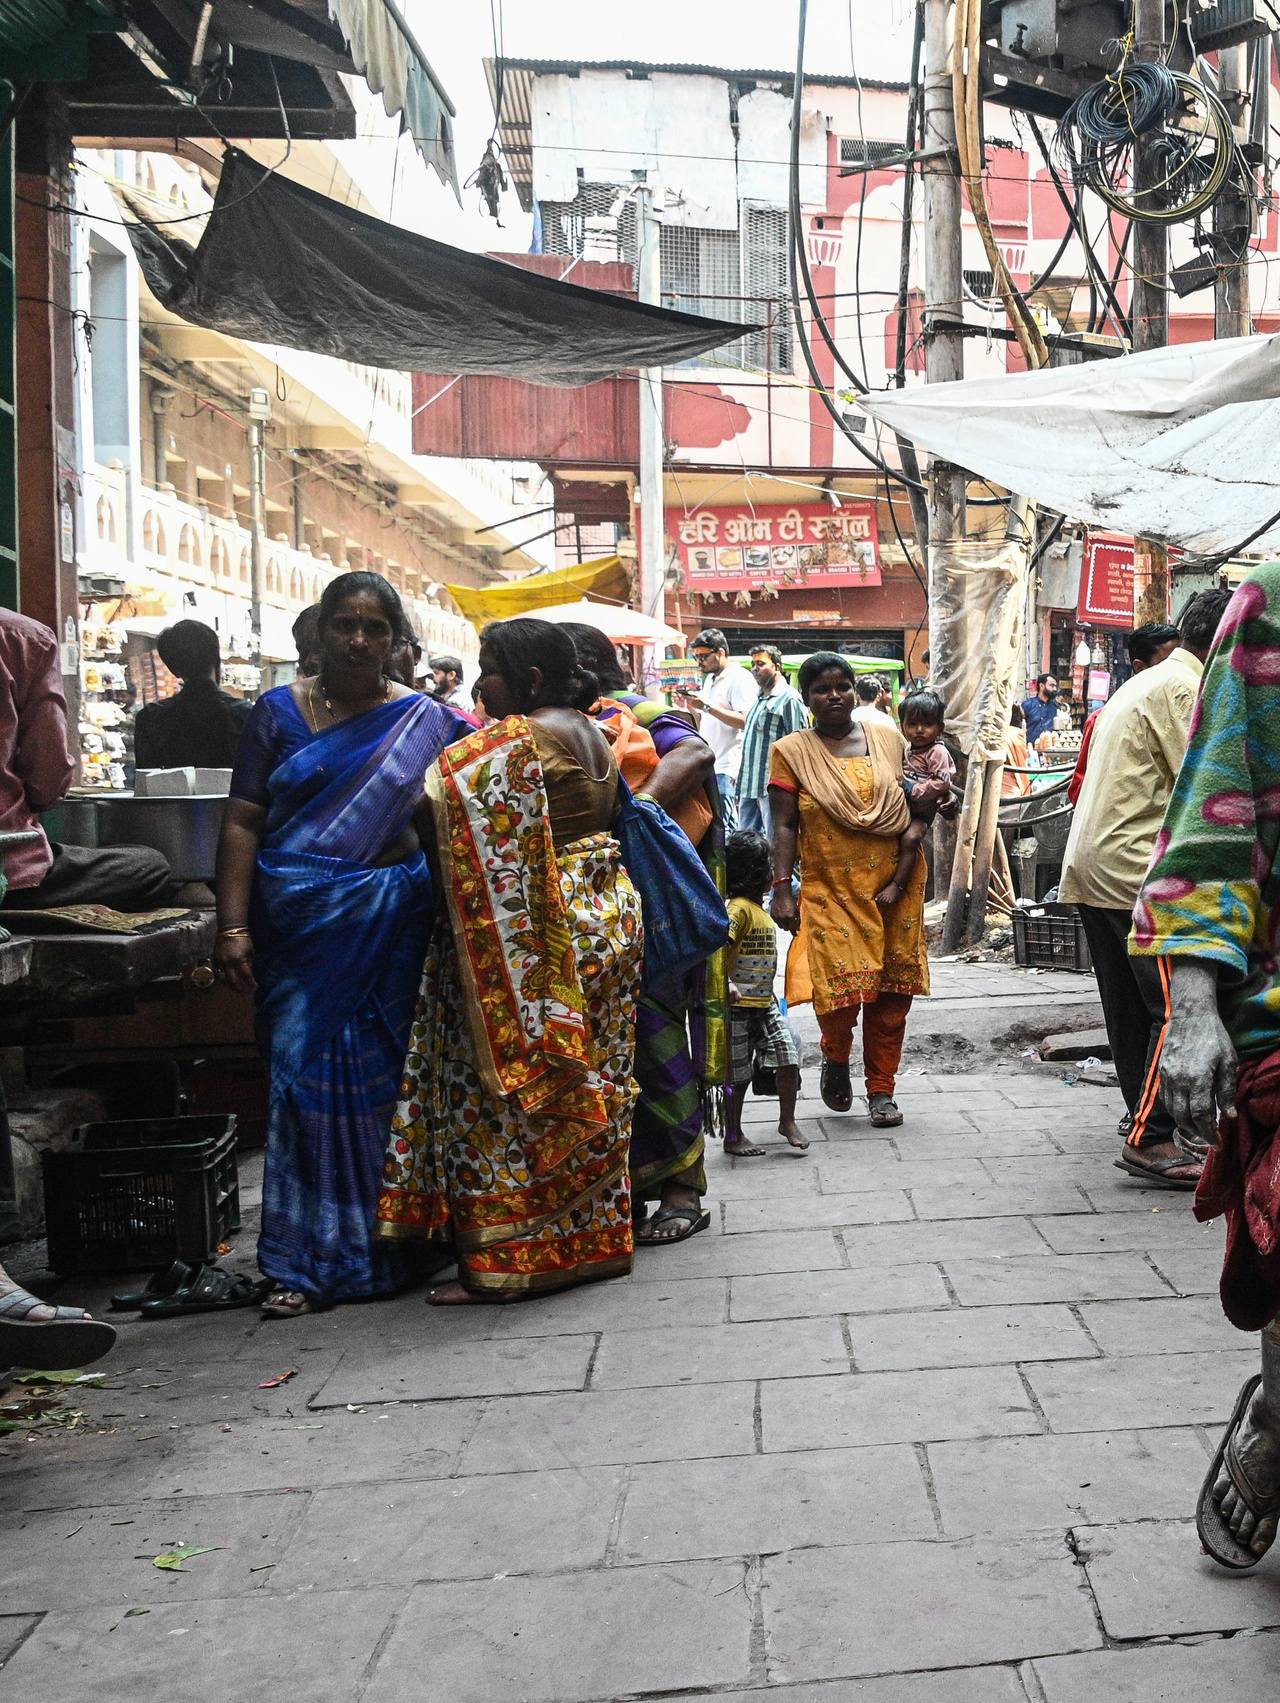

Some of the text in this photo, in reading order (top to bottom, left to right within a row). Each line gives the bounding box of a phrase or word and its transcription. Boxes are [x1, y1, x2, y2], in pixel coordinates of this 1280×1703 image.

[677, 509, 872, 544] हरि ओम टी स्टॉल
